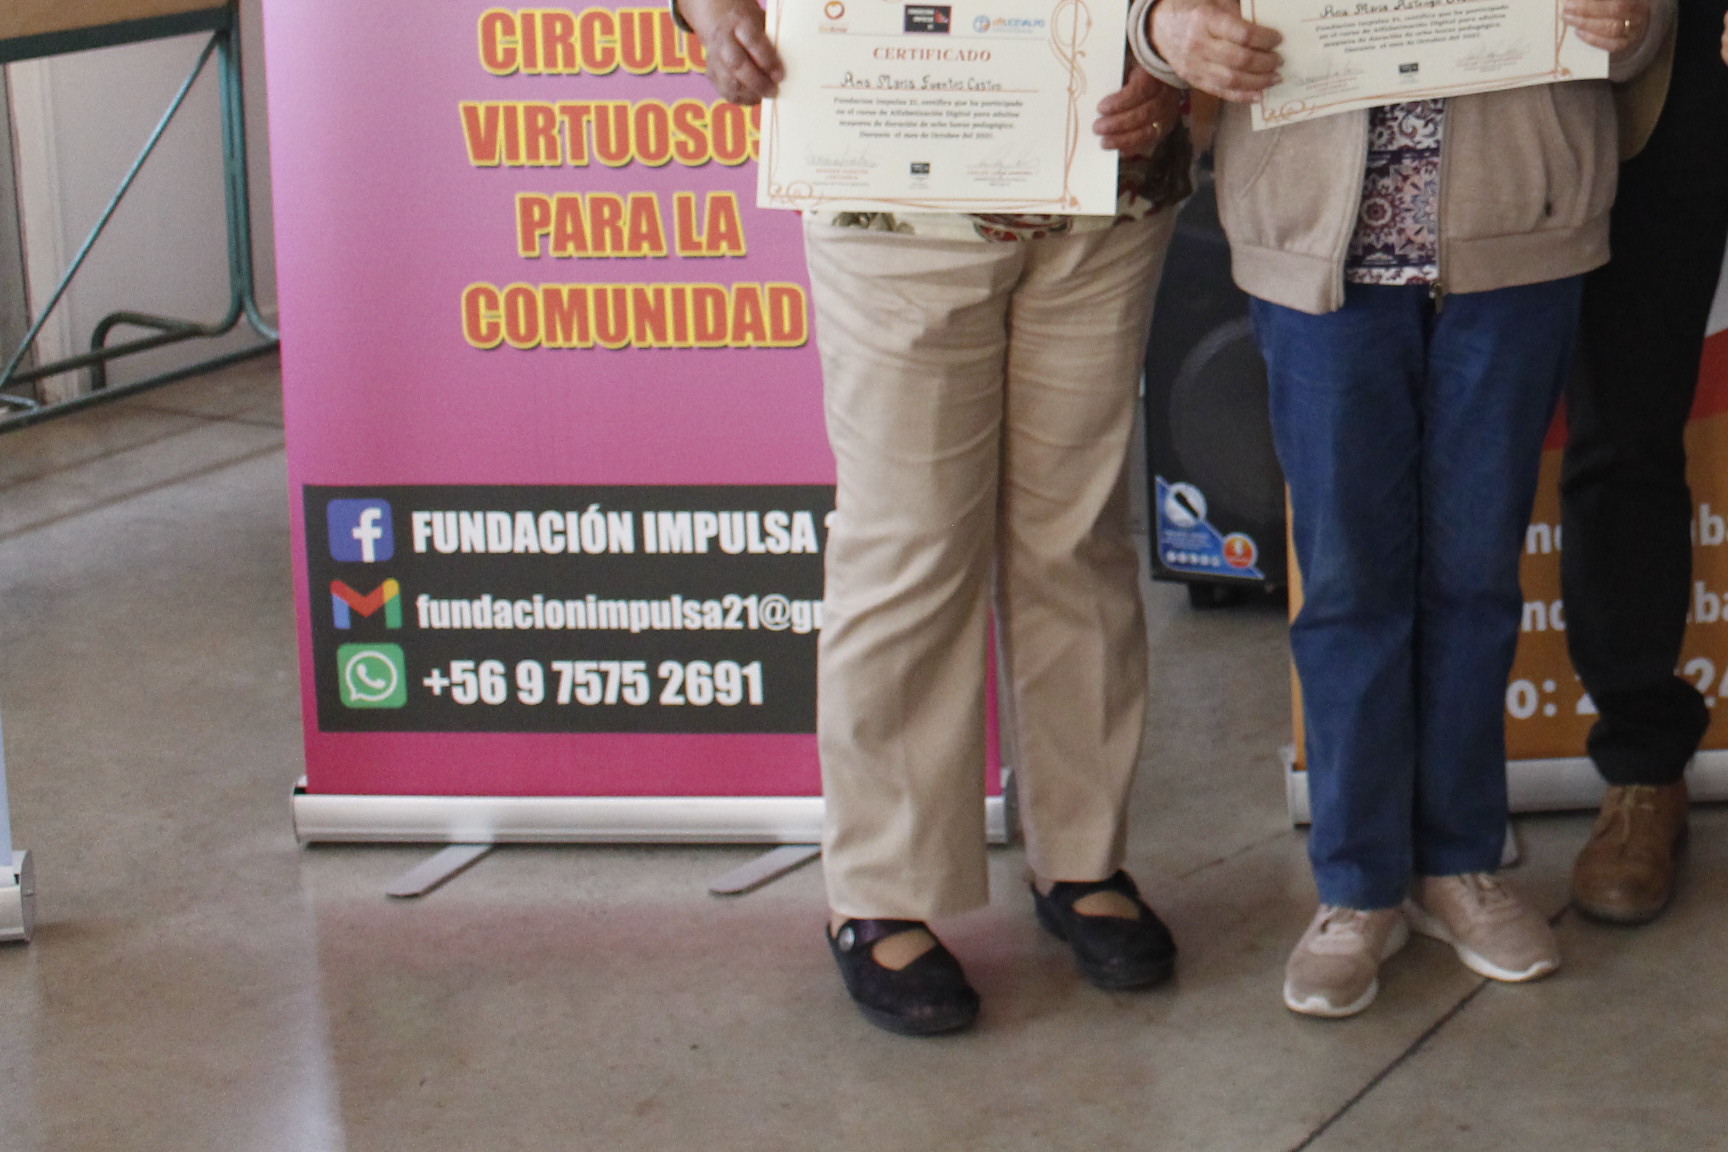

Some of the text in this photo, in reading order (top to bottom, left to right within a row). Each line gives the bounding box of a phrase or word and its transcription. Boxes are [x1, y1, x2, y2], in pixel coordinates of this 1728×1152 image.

[1320, 4, 1348, 19] Ana
[872, 47, 992, 63] CERTIFICADO
[840, 71, 871, 89] Ana
[459, 98, 761, 167] VIRTUOSO
[515, 191, 747, 259] PARA LA
[462, 281, 808, 350] COMUNIDAD
[411, 504, 819, 554] FUNDACIÓN IMPULSA
[423, 660, 764, 706] +56 9 7575 2691
